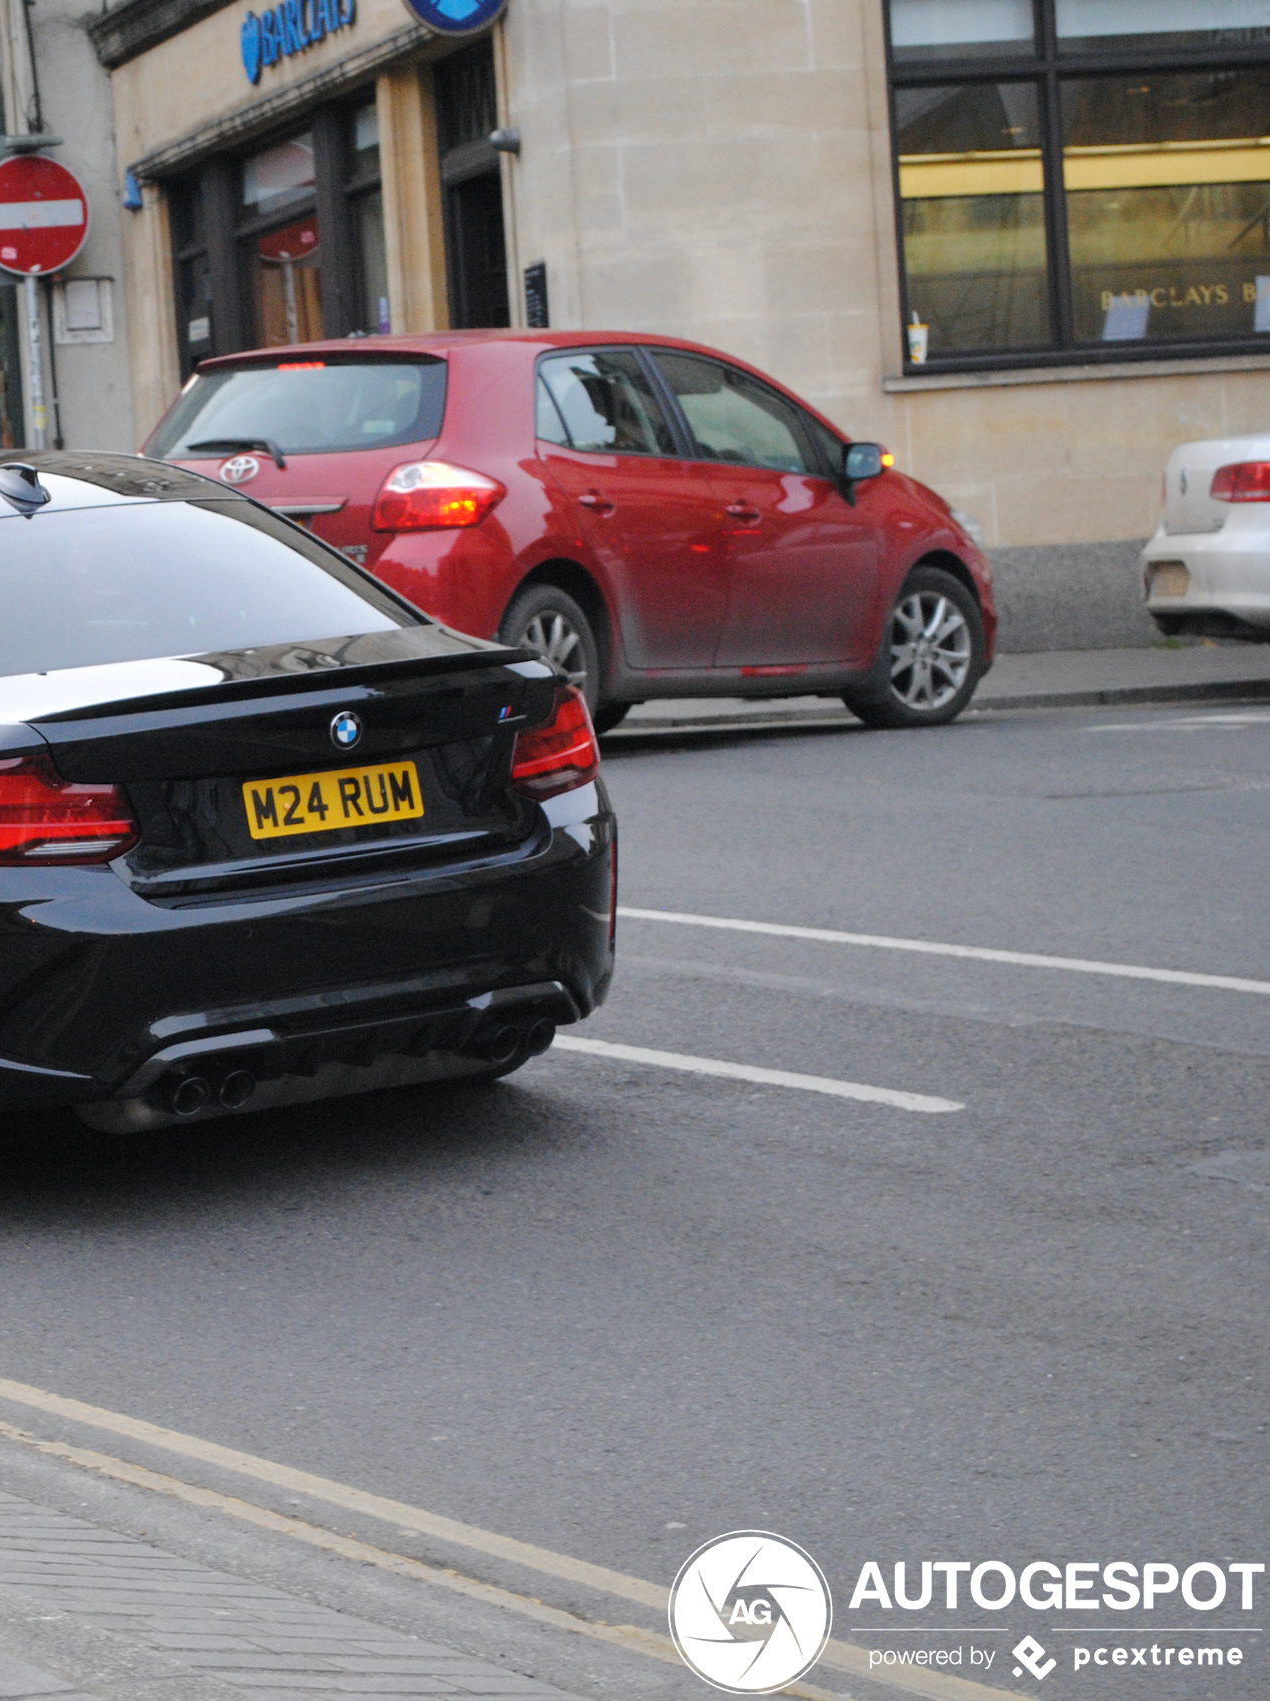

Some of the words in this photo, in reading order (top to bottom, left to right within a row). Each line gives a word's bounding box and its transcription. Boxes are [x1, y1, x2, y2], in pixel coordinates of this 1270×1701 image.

[1101, 283, 1229, 312] BARCLAYS
[251, 781, 329, 829] M24
[338, 770, 415, 818] RUM
